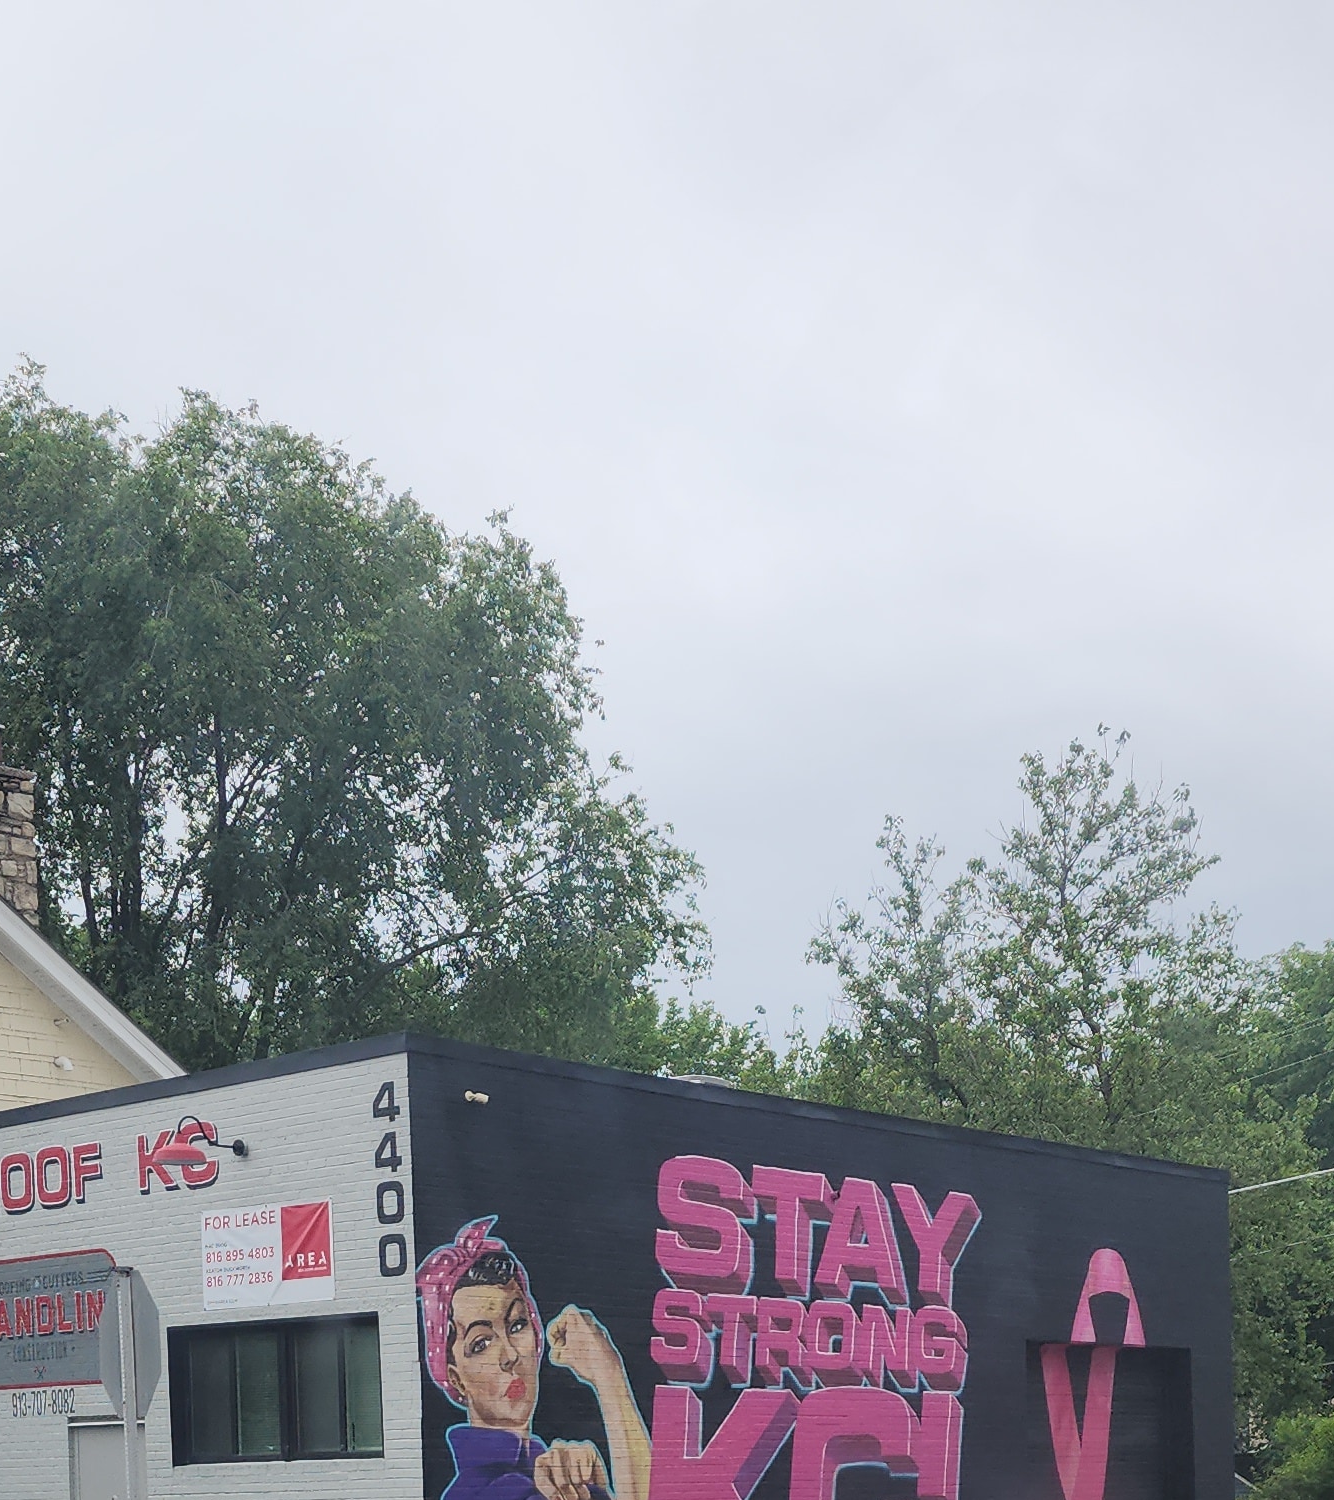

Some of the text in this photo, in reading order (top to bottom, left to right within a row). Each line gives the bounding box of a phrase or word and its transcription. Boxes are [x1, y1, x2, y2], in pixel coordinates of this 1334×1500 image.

[136, 1122, 219, 1195] KC
[373, 1081, 408, 1277] 4400
[204, 1210, 277, 1231] FOR LEASE
[655, 1155, 982, 1312] STAY
[206, 1246, 275, 1264] 816 895 4803
[284, 1250, 327, 1268] AREA
[206, 1271, 274, 1287] 816 777 2836
[650, 1288, 968, 1397] STRONG
[11, 1388, 76, 1418] 913-707-8082
